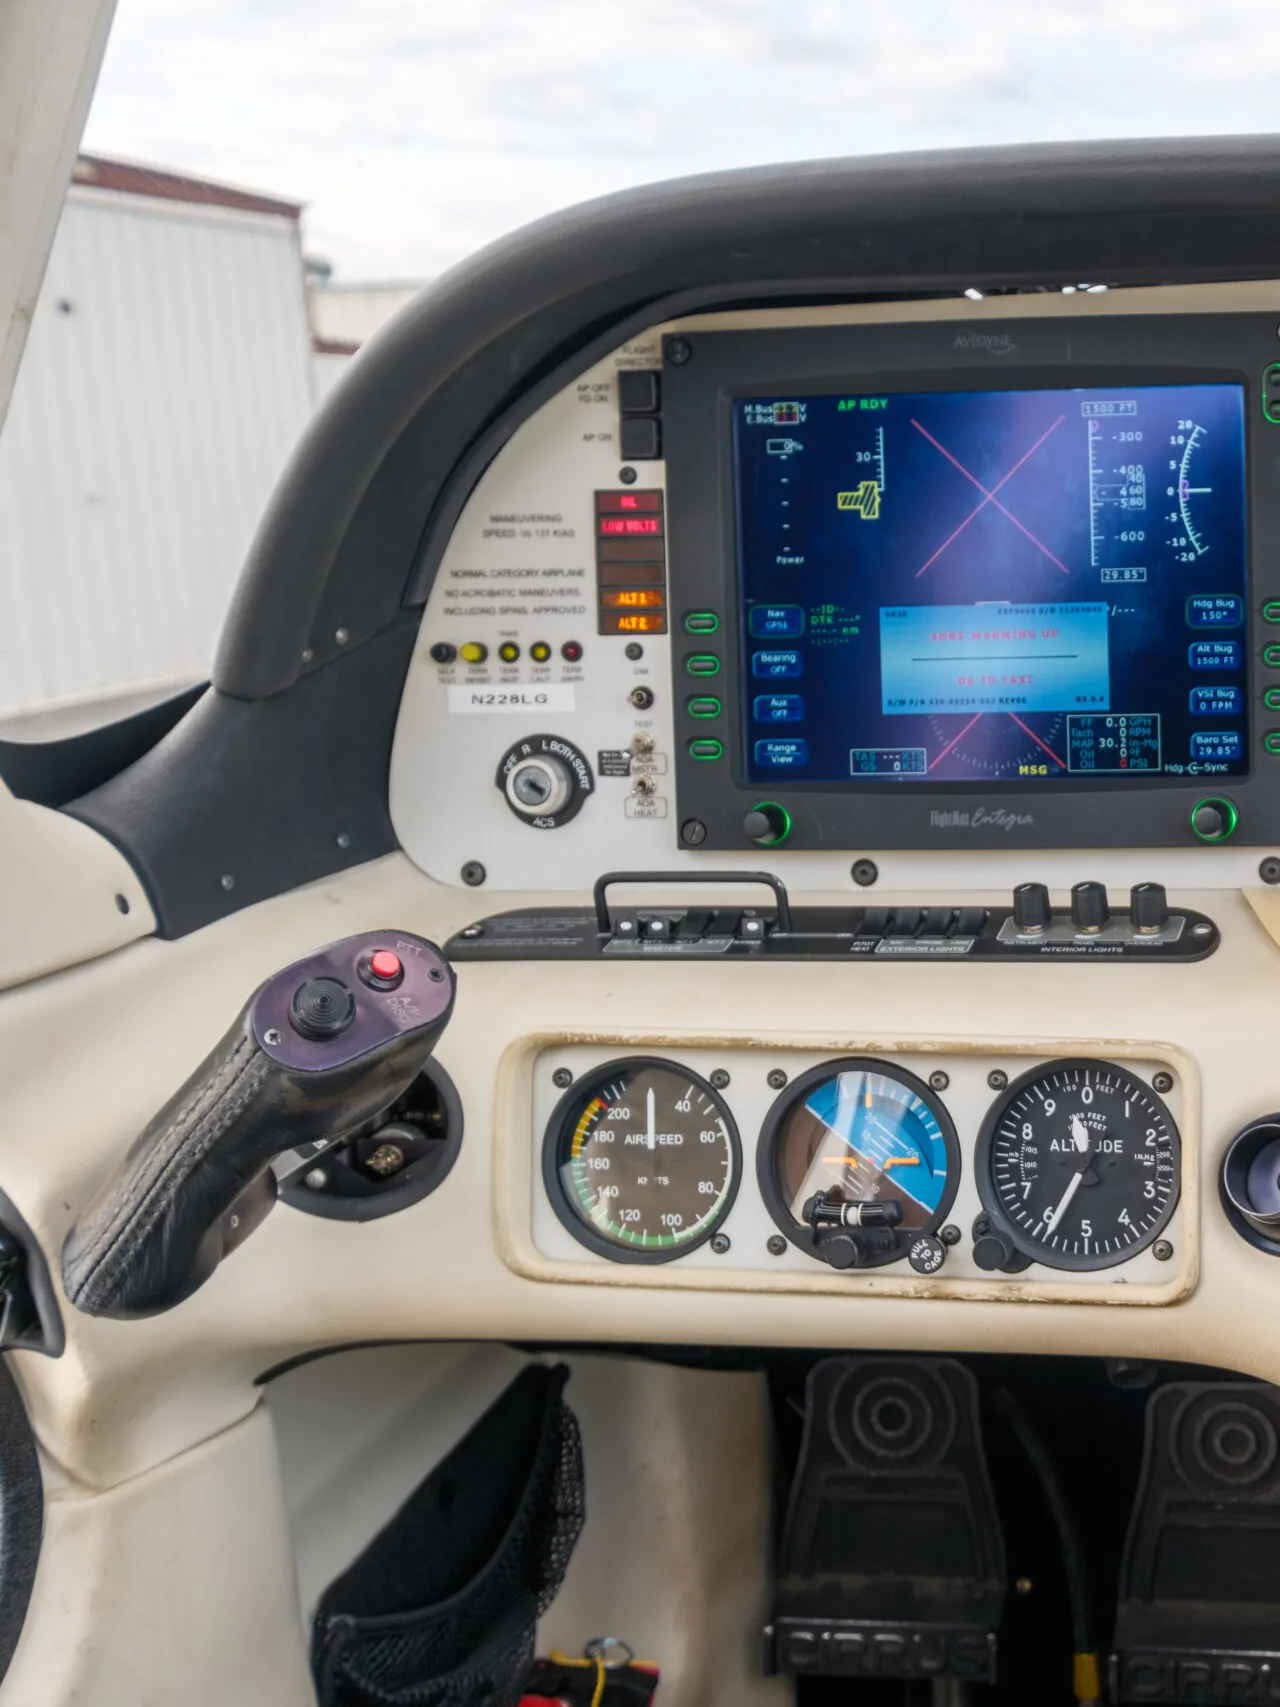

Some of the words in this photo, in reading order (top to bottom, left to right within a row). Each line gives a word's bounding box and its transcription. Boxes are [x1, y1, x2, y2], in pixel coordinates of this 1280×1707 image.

[838, 400, 855, 410] AP
[860, 399, 888, 409] RDY
[856, 452, 870, 462] 30
[490, 514, 562, 523] MANEUVERING
[602, 520, 624, 532] LOW
[626, 520, 658, 532] VOLTS
[451, 569, 488, 577] NORMAL
[490, 569, 539, 577] CATEGORY
[542, 569, 585, 577] AIRPLANE
[1194, 600, 1212, 608] Hdg
[1216, 600, 1234, 608] Bug
[761, 654, 795, 663] Bearing
[471, 693, 548, 705] N228LG
[767, 744, 795, 753] Range
[771, 755, 792, 763] View
[1019, 765, 1047, 775] MSG
[675, 1100, 691, 1112] 40
[607, 1108, 630, 1120] 200
[594, 1131, 614, 1142] 180
[700, 1131, 715, 1142] 60
[589, 1158, 610, 1169] 160
[597, 1186, 619, 1197] 140
[698, 1182, 713, 1193] 80
[619, 1210, 641, 1220] 120
[661, 1215, 682, 1225] 100
